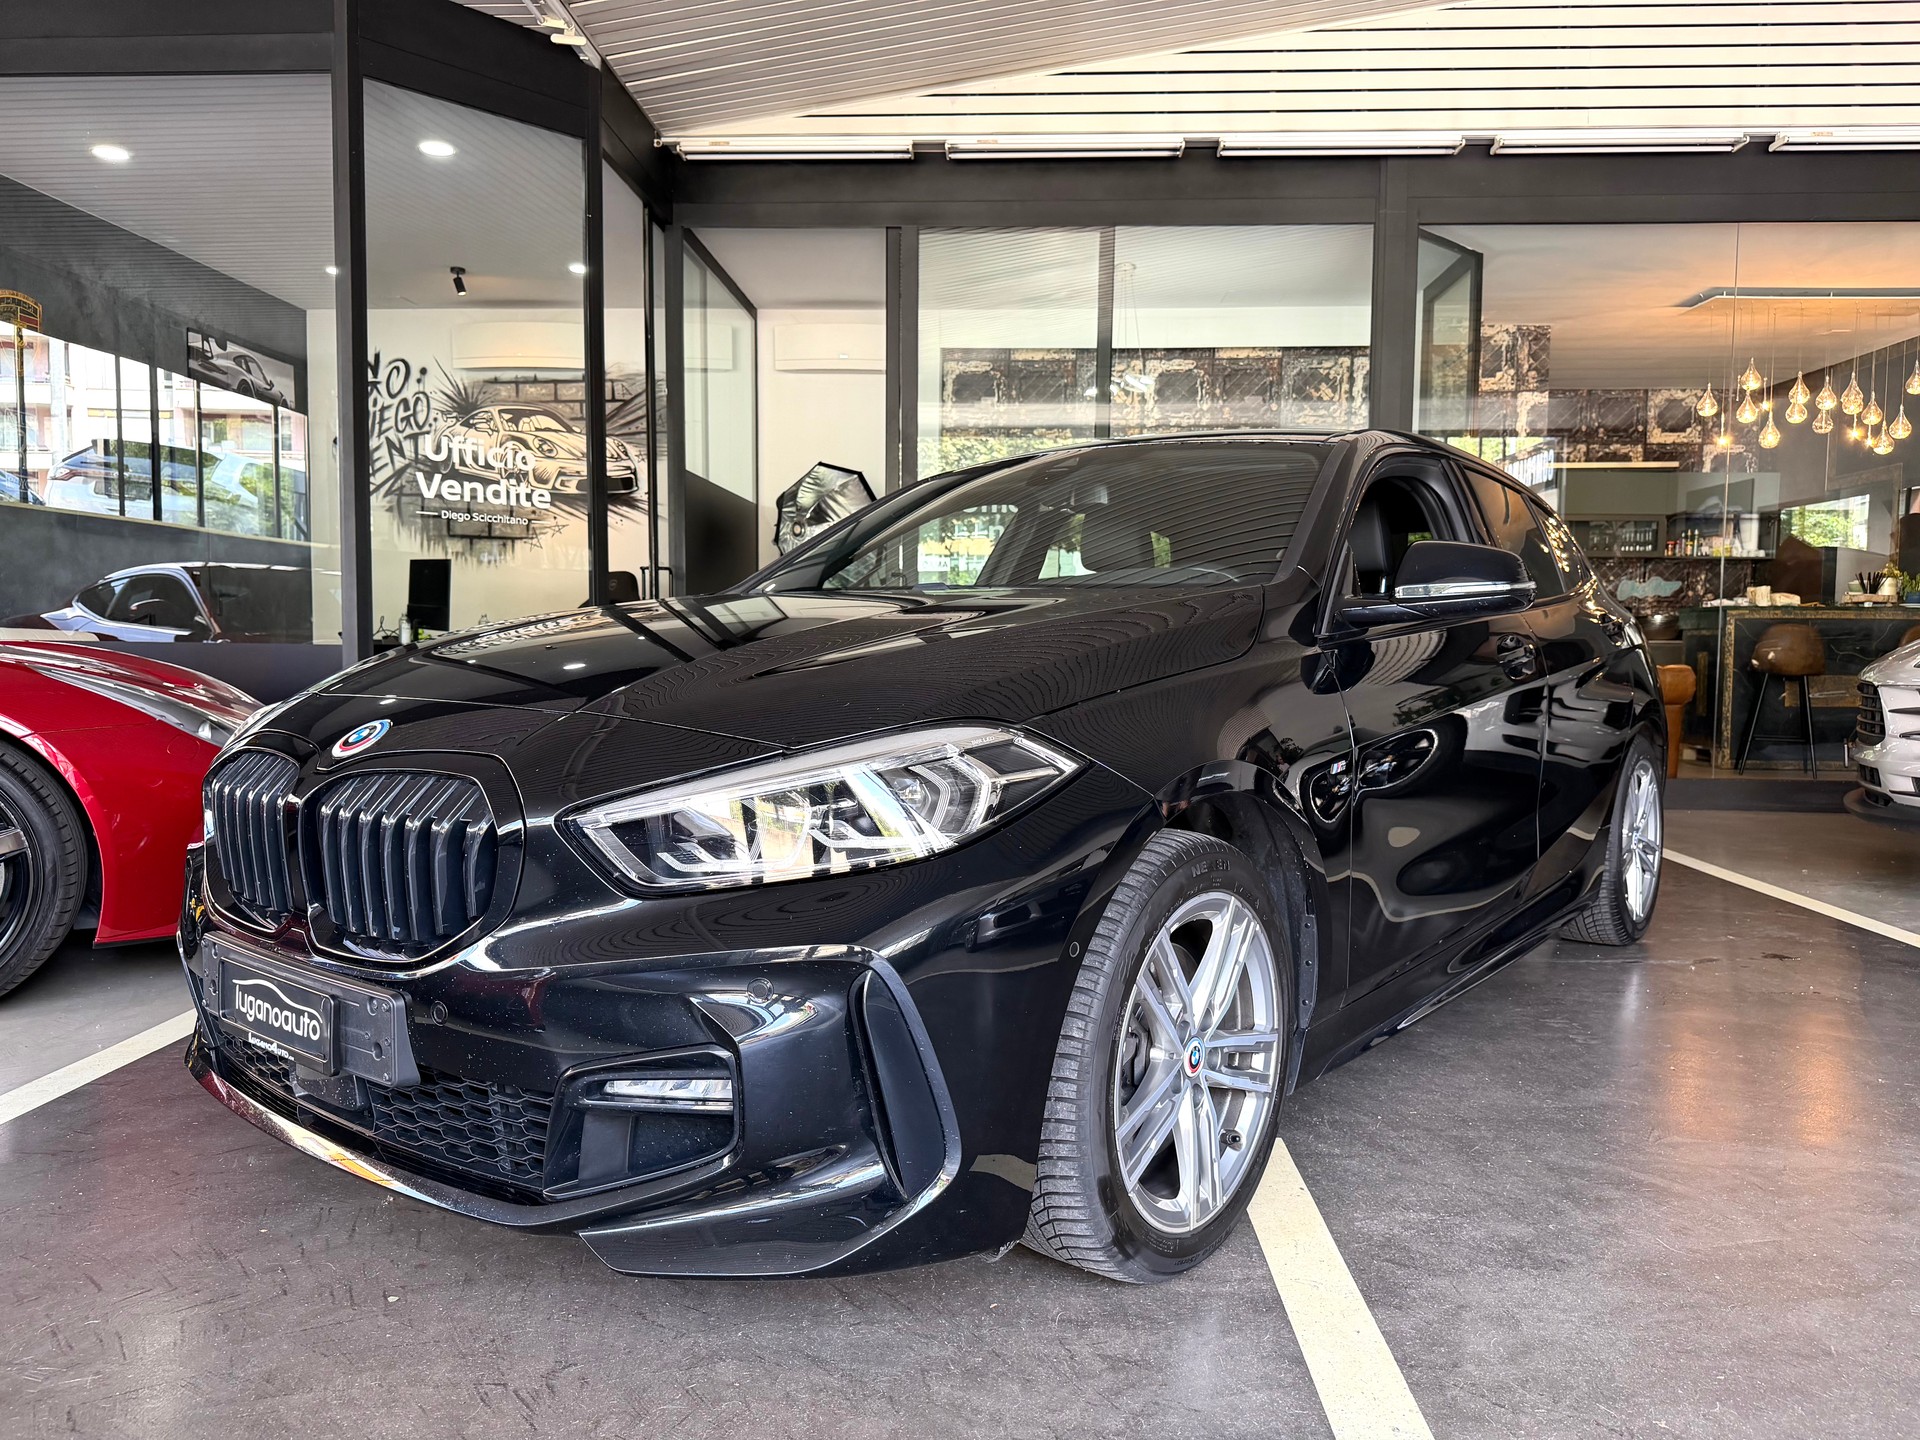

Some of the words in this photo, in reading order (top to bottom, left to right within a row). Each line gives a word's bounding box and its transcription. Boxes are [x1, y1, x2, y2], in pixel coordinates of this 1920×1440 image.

[423, 434, 536, 471] Ufficio
[415, 472, 552, 509] Vendite
[441, 510, 471, 523] Diego
[472, 512, 529, 526] Scicchitano
[235, 984, 320, 1041] luganoauto
